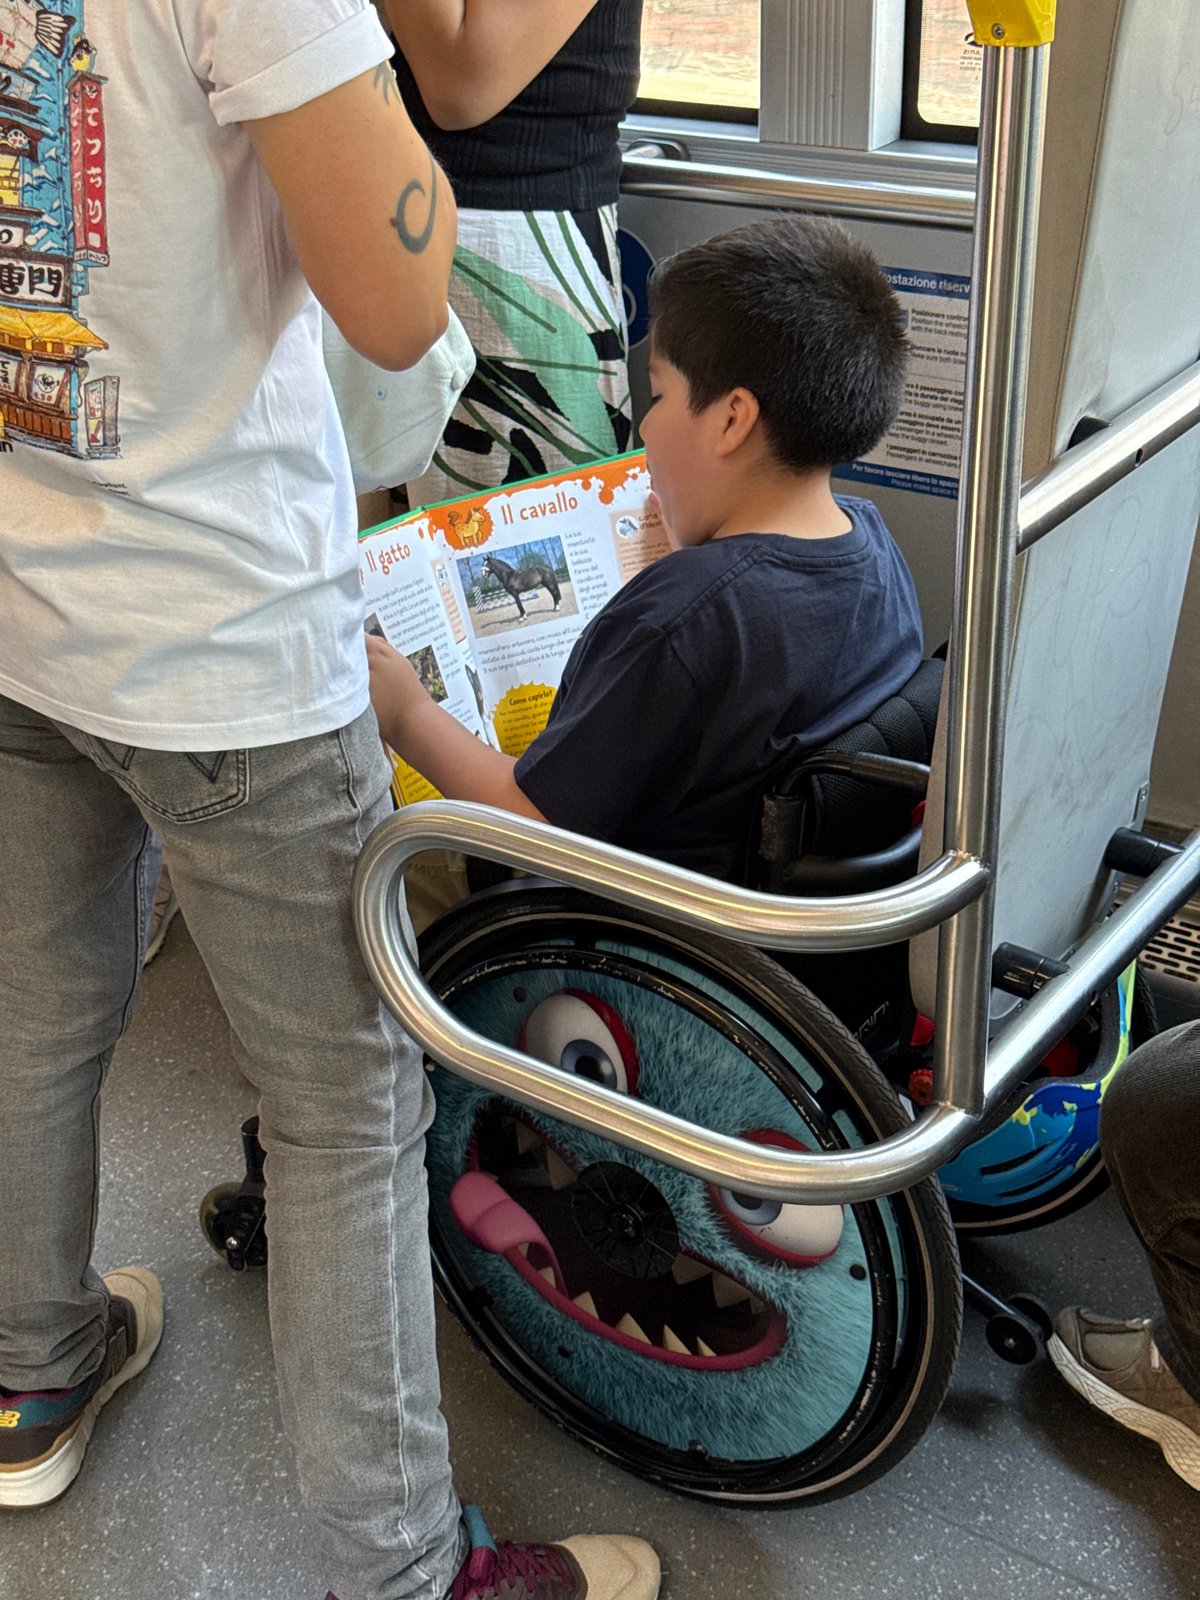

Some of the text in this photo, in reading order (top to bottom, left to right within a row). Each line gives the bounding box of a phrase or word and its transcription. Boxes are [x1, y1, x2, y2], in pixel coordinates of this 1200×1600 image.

[886, 273, 970, 293] ostazione riserv
[947, 314, 968, 322] contro
[0, 440, 14, 452] n
[501, 491, 578, 527] Il cavallo
[365, 542, 411, 575] Il gatto
[509, 692, 552, 705] Come capirlo?
